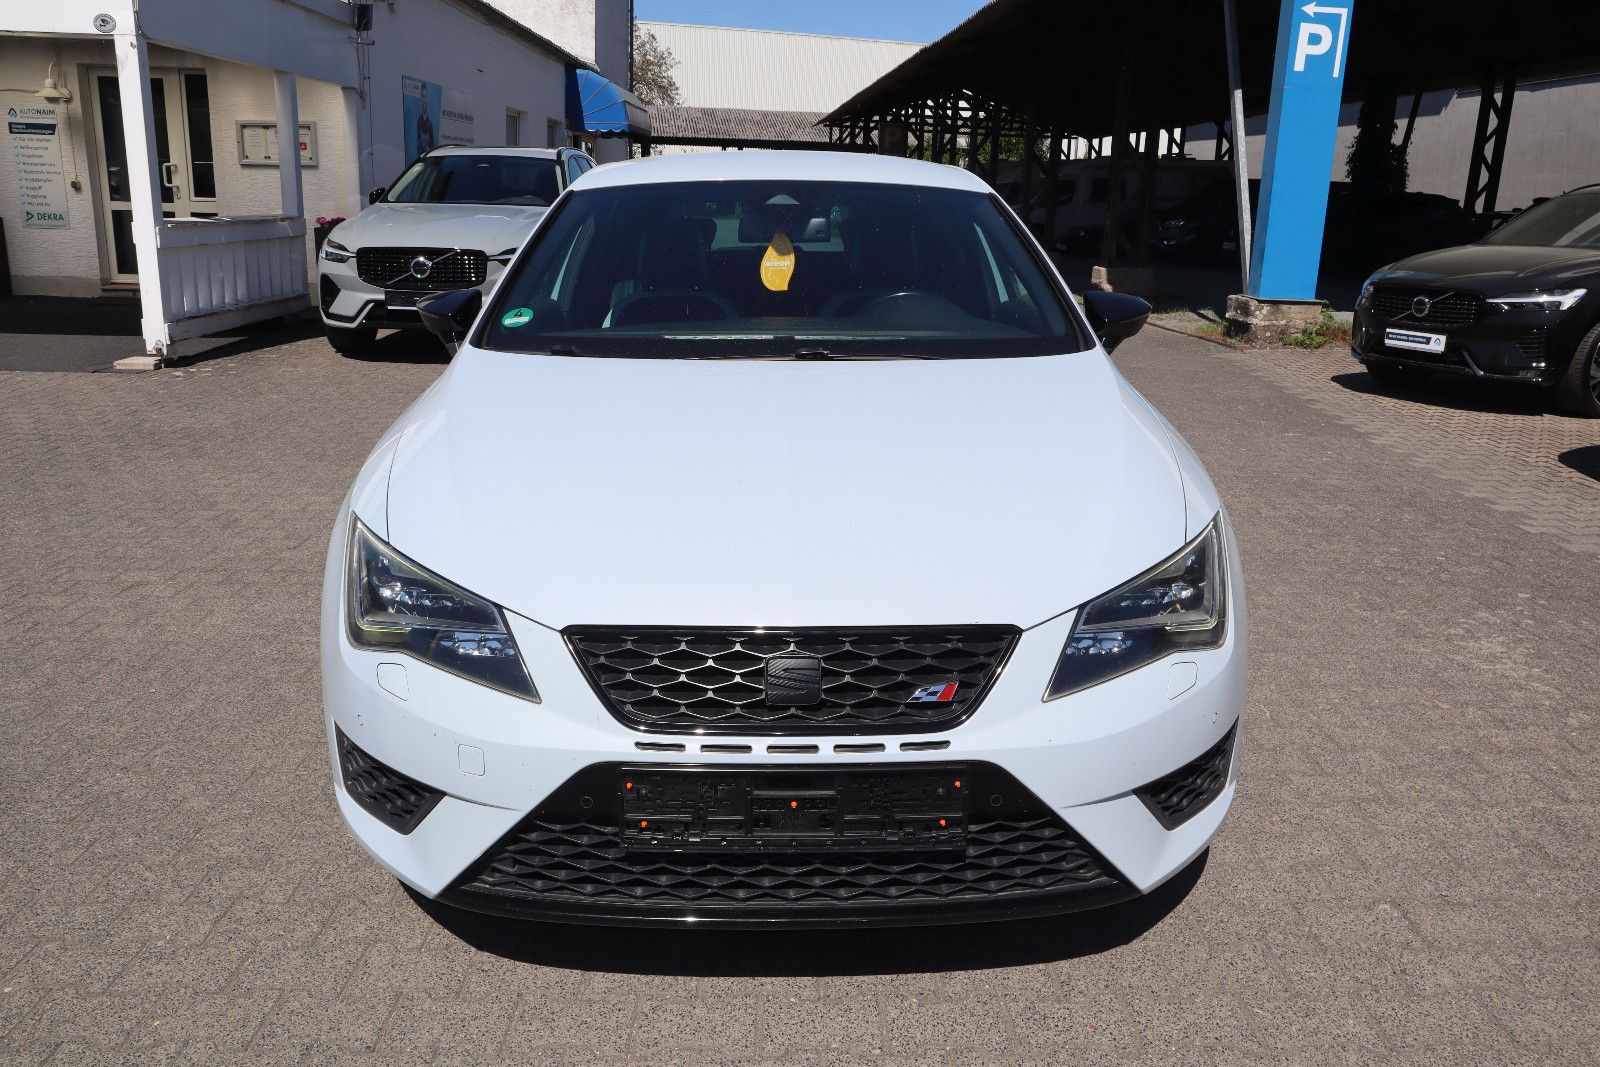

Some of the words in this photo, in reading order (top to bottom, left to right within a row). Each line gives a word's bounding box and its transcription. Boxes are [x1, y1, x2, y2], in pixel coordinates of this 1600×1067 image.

[1294, 22, 1333, 72] P
[36, 212, 65, 221] DEKRA
[514, 308, 523, 317] 4
